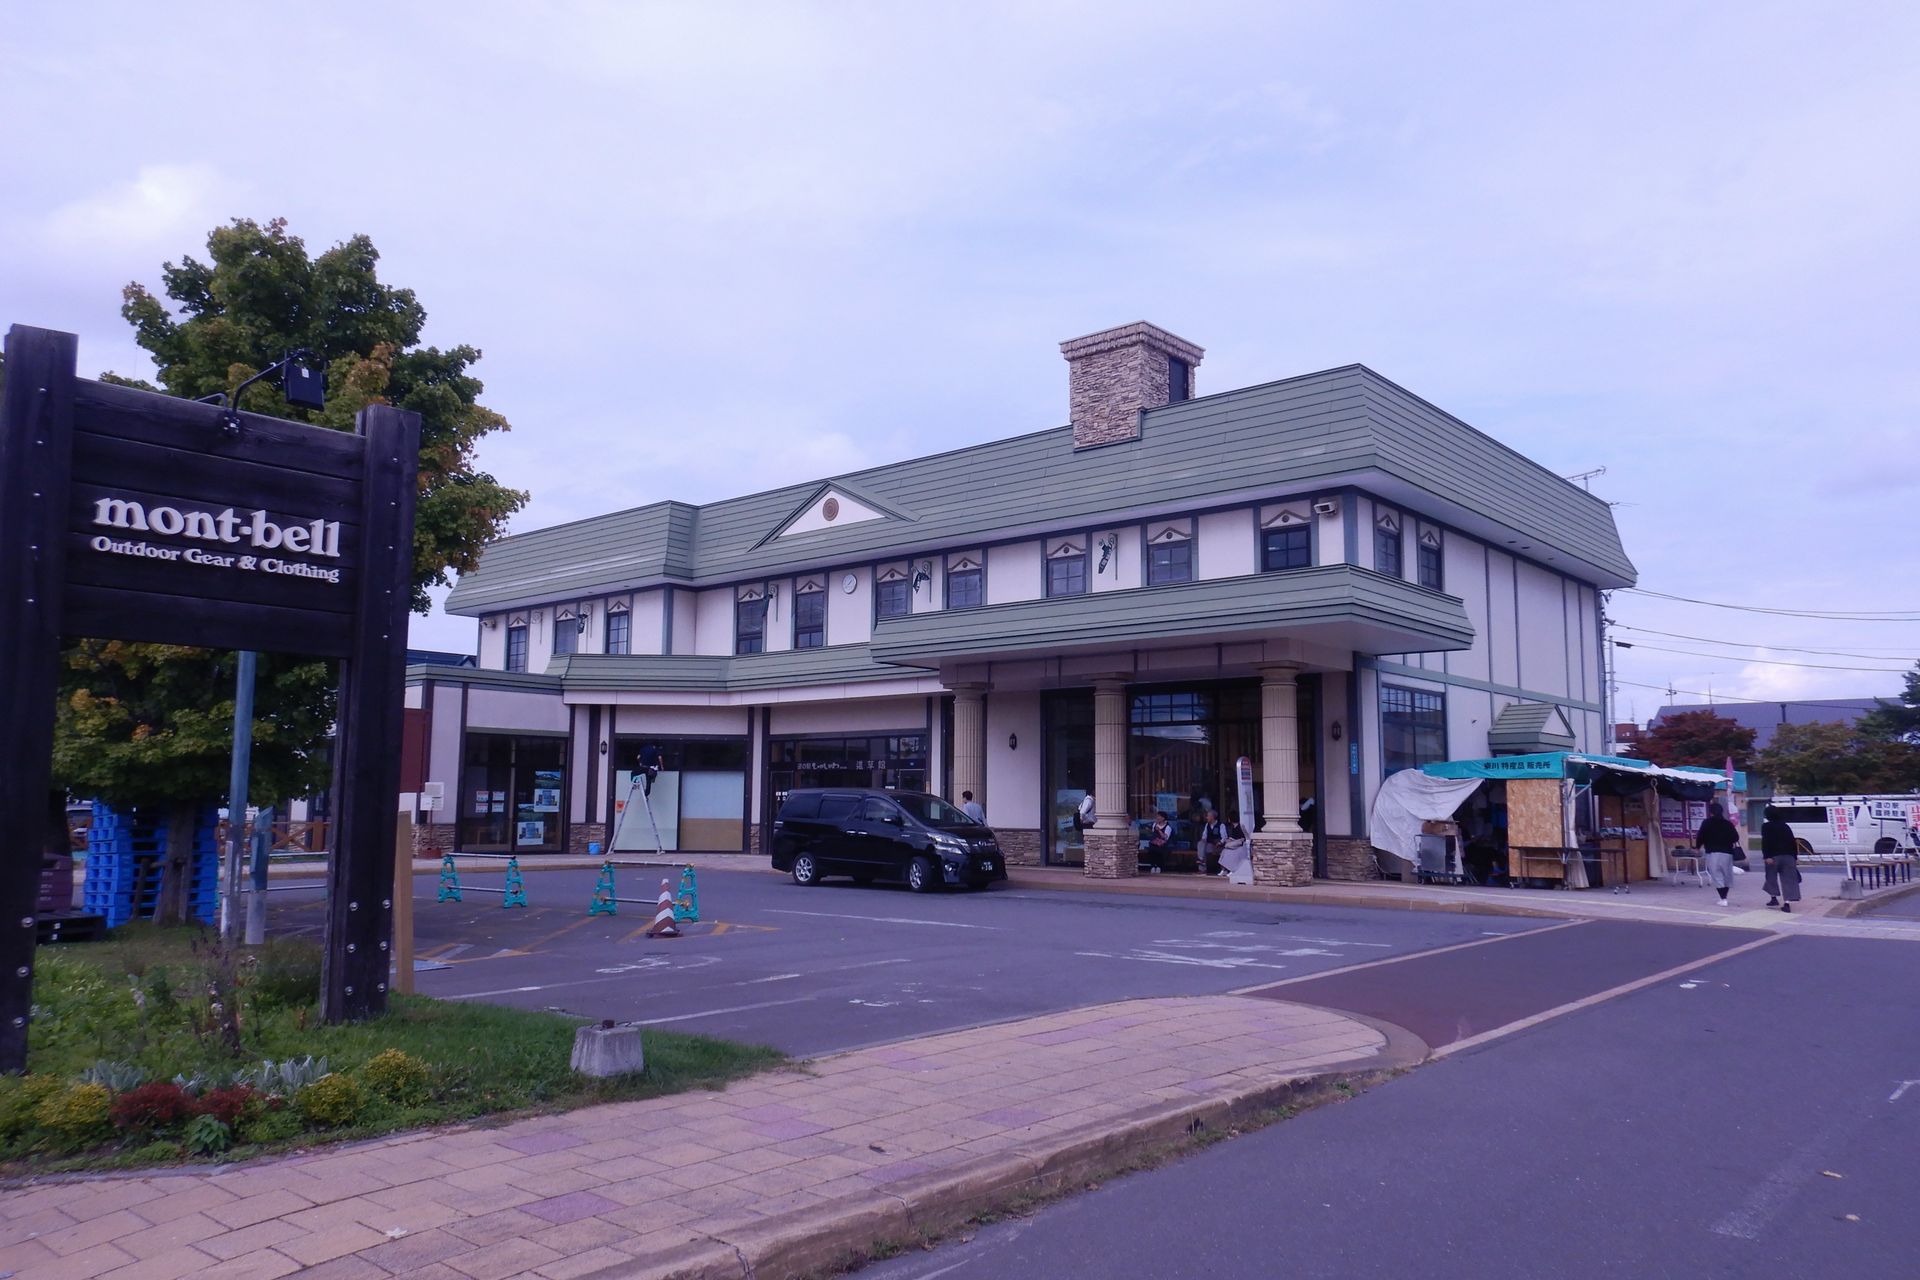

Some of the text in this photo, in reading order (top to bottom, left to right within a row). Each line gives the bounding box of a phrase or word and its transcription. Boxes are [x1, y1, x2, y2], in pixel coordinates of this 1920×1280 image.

[93, 498, 340, 557] mont-bell
[90, 536, 340, 583] Outdoor Gear & Clothing
[1834, 807, 1849, 840] 駐車禁止
